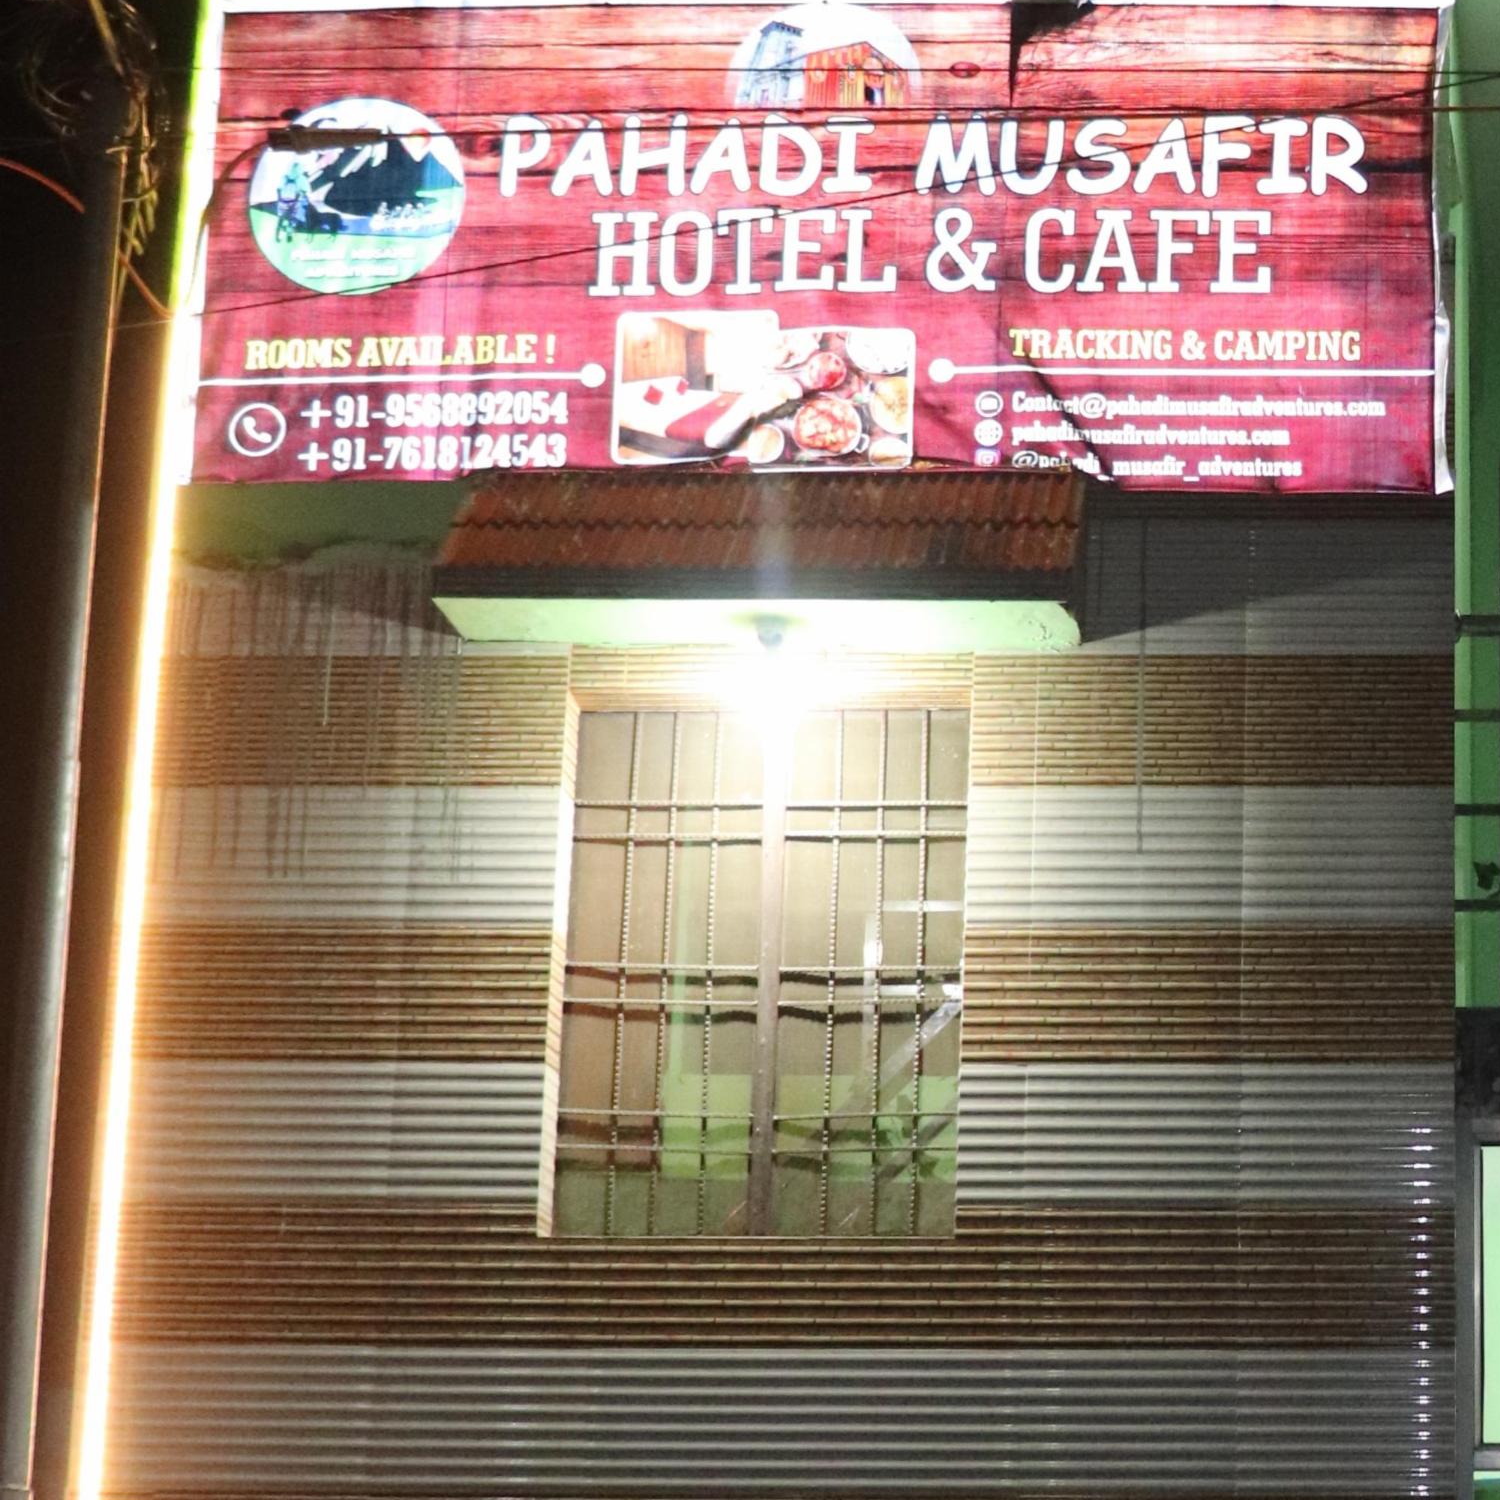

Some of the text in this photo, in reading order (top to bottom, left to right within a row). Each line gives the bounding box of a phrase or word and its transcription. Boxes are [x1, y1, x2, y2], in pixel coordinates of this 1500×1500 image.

[499, 112, 1368, 197] PAHADI MUSAFIR
[587, 207, 1272, 297] HOTEL & CAFE
[244, 337, 352, 370] ROOMS
[356, 334, 538, 368] AVAILABLE
[1008, 328, 1361, 361] TRACKING & CAMPING
[297, 434, 568, 472] +91-7618124543
